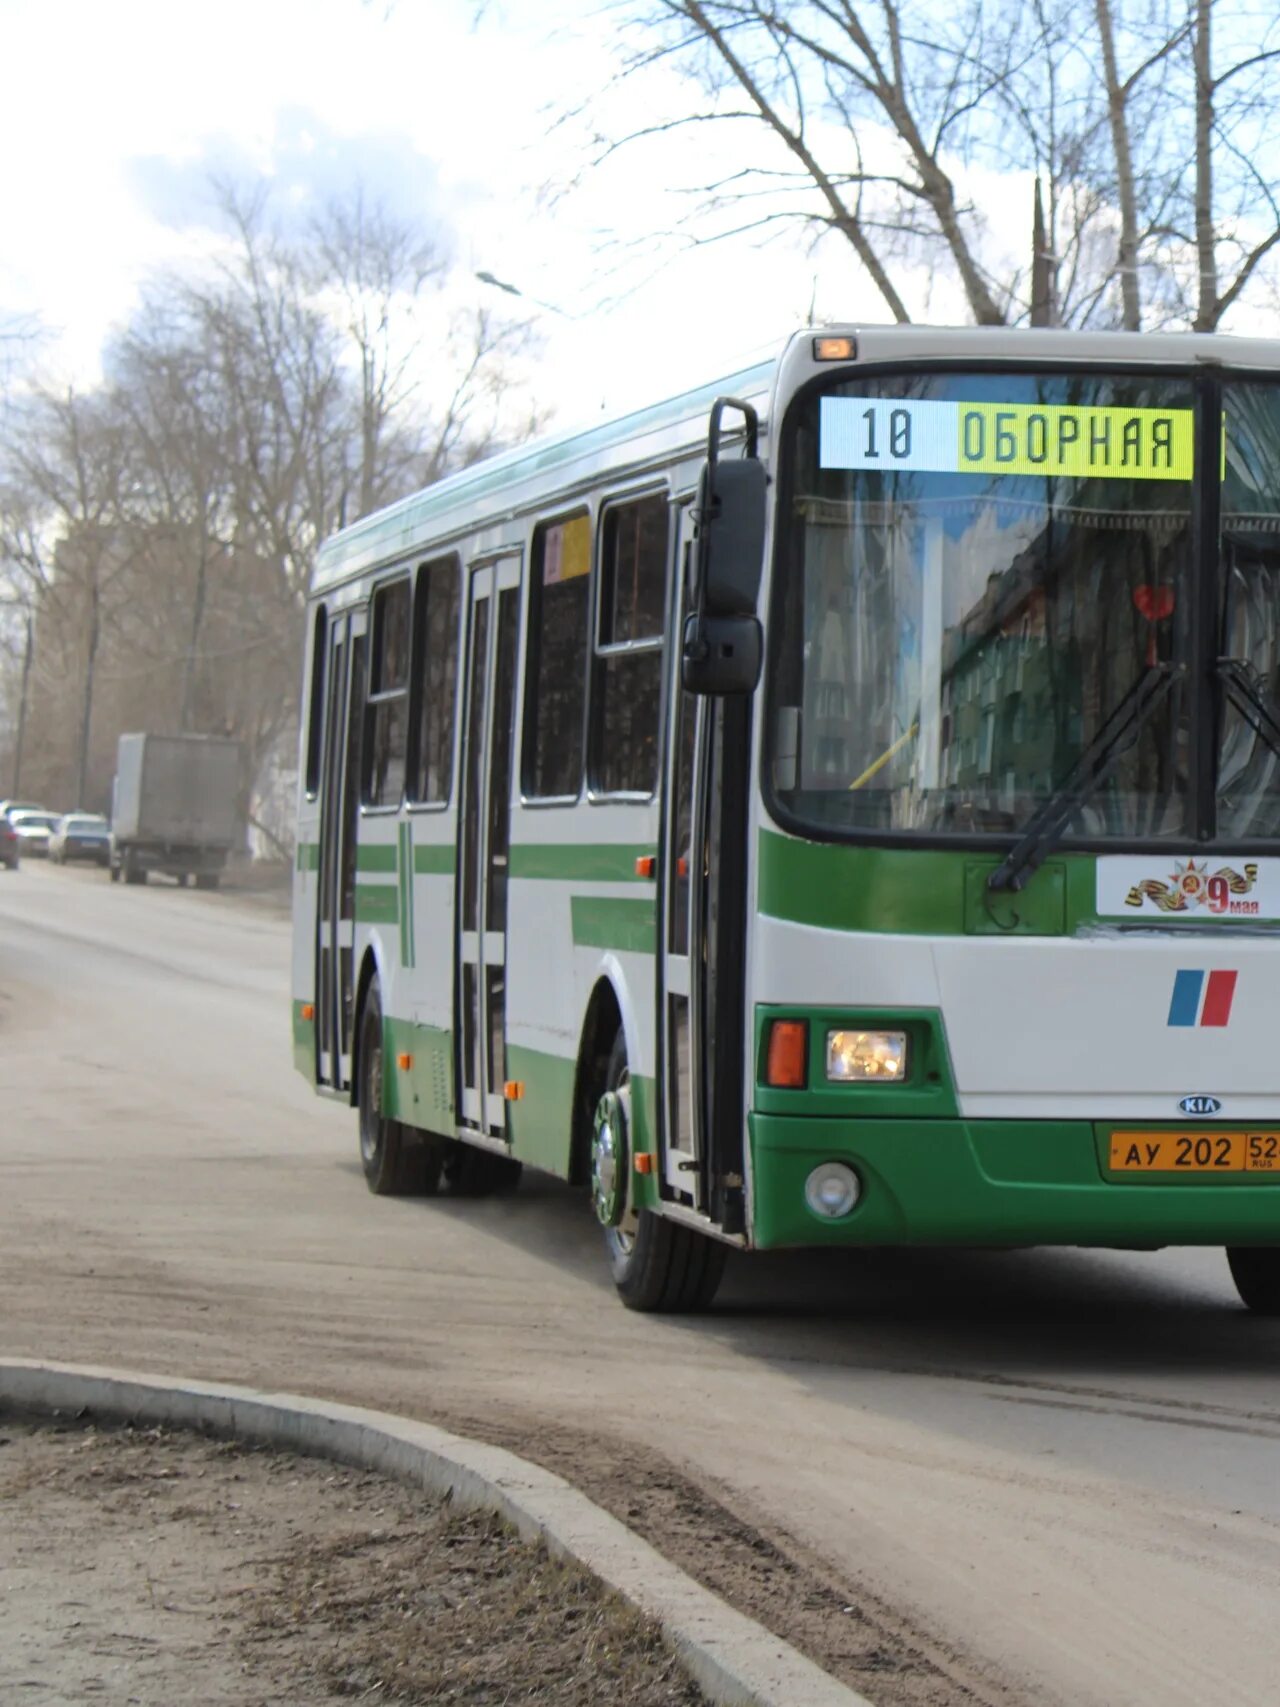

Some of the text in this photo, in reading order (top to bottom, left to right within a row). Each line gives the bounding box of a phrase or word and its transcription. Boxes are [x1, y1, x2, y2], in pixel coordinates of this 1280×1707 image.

[862, 407, 1174, 468] 10 ОБОРНАЯ
[1207, 876, 1230, 914] 9
[1184, 1098, 1217, 1113] KIA
[1124, 1136, 1278, 1167] АУ 202 52
[1252, 1160, 1274, 1169] RUS
